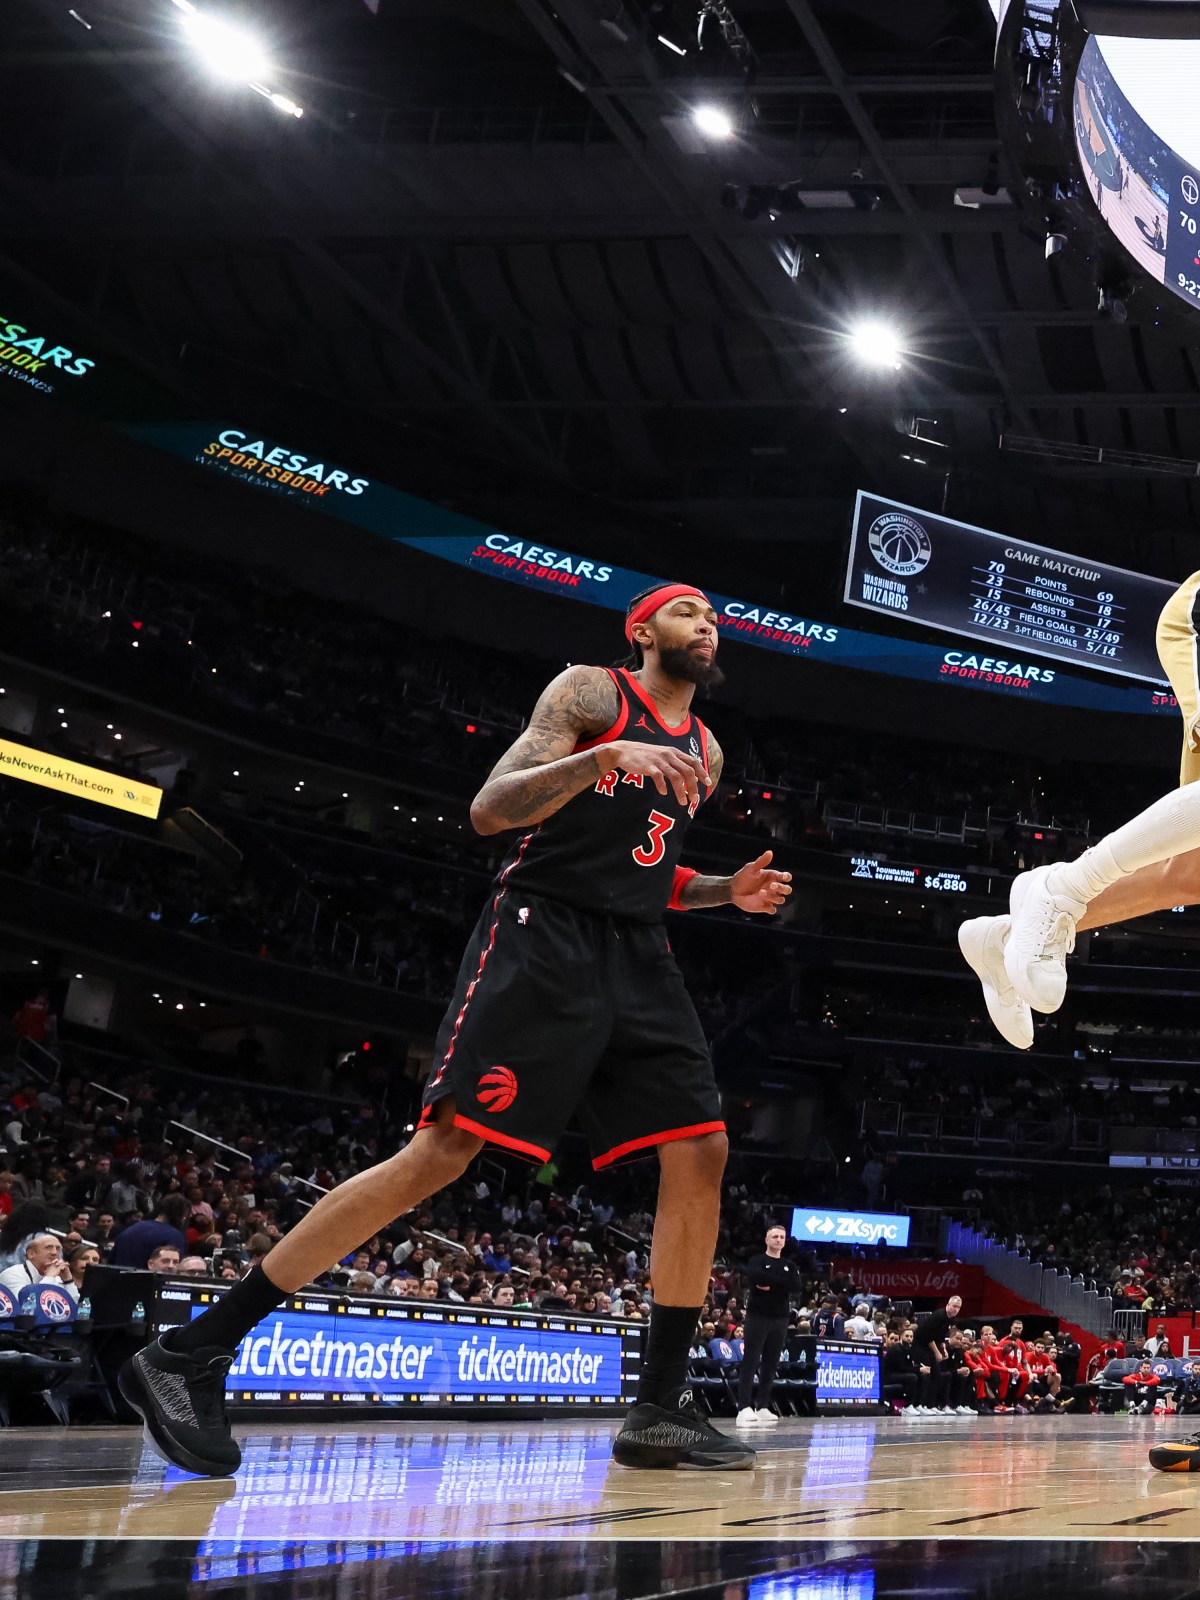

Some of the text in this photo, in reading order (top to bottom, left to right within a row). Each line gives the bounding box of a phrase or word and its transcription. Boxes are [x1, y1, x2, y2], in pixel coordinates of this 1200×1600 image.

[1179, 211, 1197, 234] 70
[204, 443, 330, 496] SPORTSBOOK
[219, 430, 369, 495] CAESARS
[878, 515, 925, 539] WASHINGTON
[472, 545, 583, 588] SPORTSBOOK
[485, 534, 613, 582] CAESARS
[879, 555, 917, 572] WIZARDS
[1004, 548, 1102, 582] GAME MATCHUP
[864, 573, 906, 594] WASHINGTON
[986, 574, 1112, 616] 23 REBOUNDS 18
[988, 560, 1114, 603] 70 POINTS 69
[862, 584, 909, 611] WIZARDS
[986, 588, 1112, 629] 15 ASSISTS 17
[717, 614, 812, 647] SPORTSBOOK
[724, 603, 838, 642] CAESARS
[973, 598, 1120, 645] 26/45 FIELD GOALS 25/49
[973, 612, 1116, 658] 12/23 3-PT FIELD GOALS 5/14
[940, 664, 1031, 689] SPORTSBOOK
[944, 652, 1056, 683] CAESARS
[632, 809, 675, 866] 3
[867, 859, 878, 867] PM
[876, 866, 915, 877] FOUNDATION
[937, 872, 960, 880] JACKPOT
[894, 875, 914, 884] RAFFLE
[924, 875, 967, 892] $6,880
[835, 1217, 898, 1241] ZKsync
[924, 1270, 960, 1290] Lofts
[457, 1335, 602, 1384] ticketmaster
[817, 1361, 875, 1389] ticketmaster
